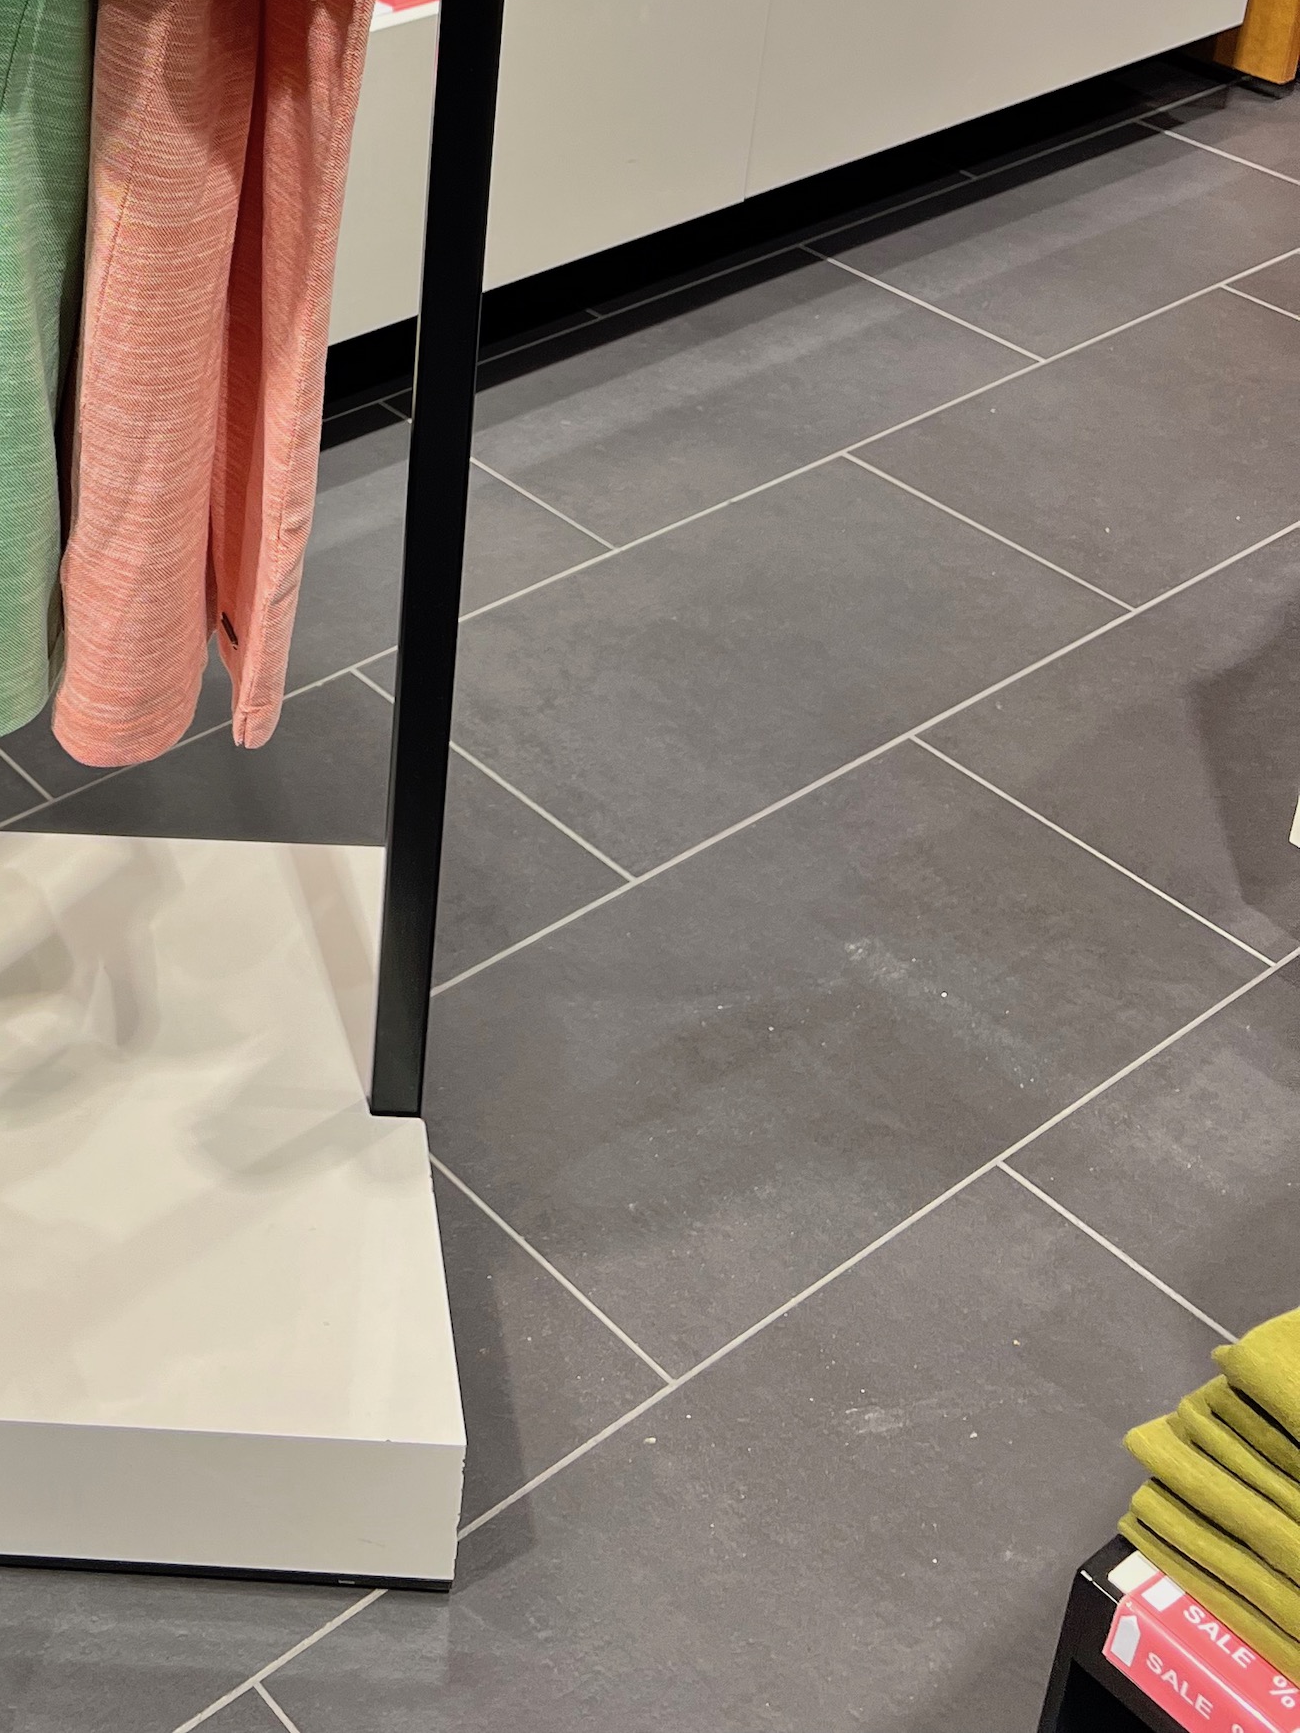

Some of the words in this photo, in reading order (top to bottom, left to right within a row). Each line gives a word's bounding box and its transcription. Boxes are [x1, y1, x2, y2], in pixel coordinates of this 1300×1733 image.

[1146, 1652, 1214, 1721] SALE
[1183, 1605, 1256, 1669] SALE
[1269, 1675, 1300, 1708] %
